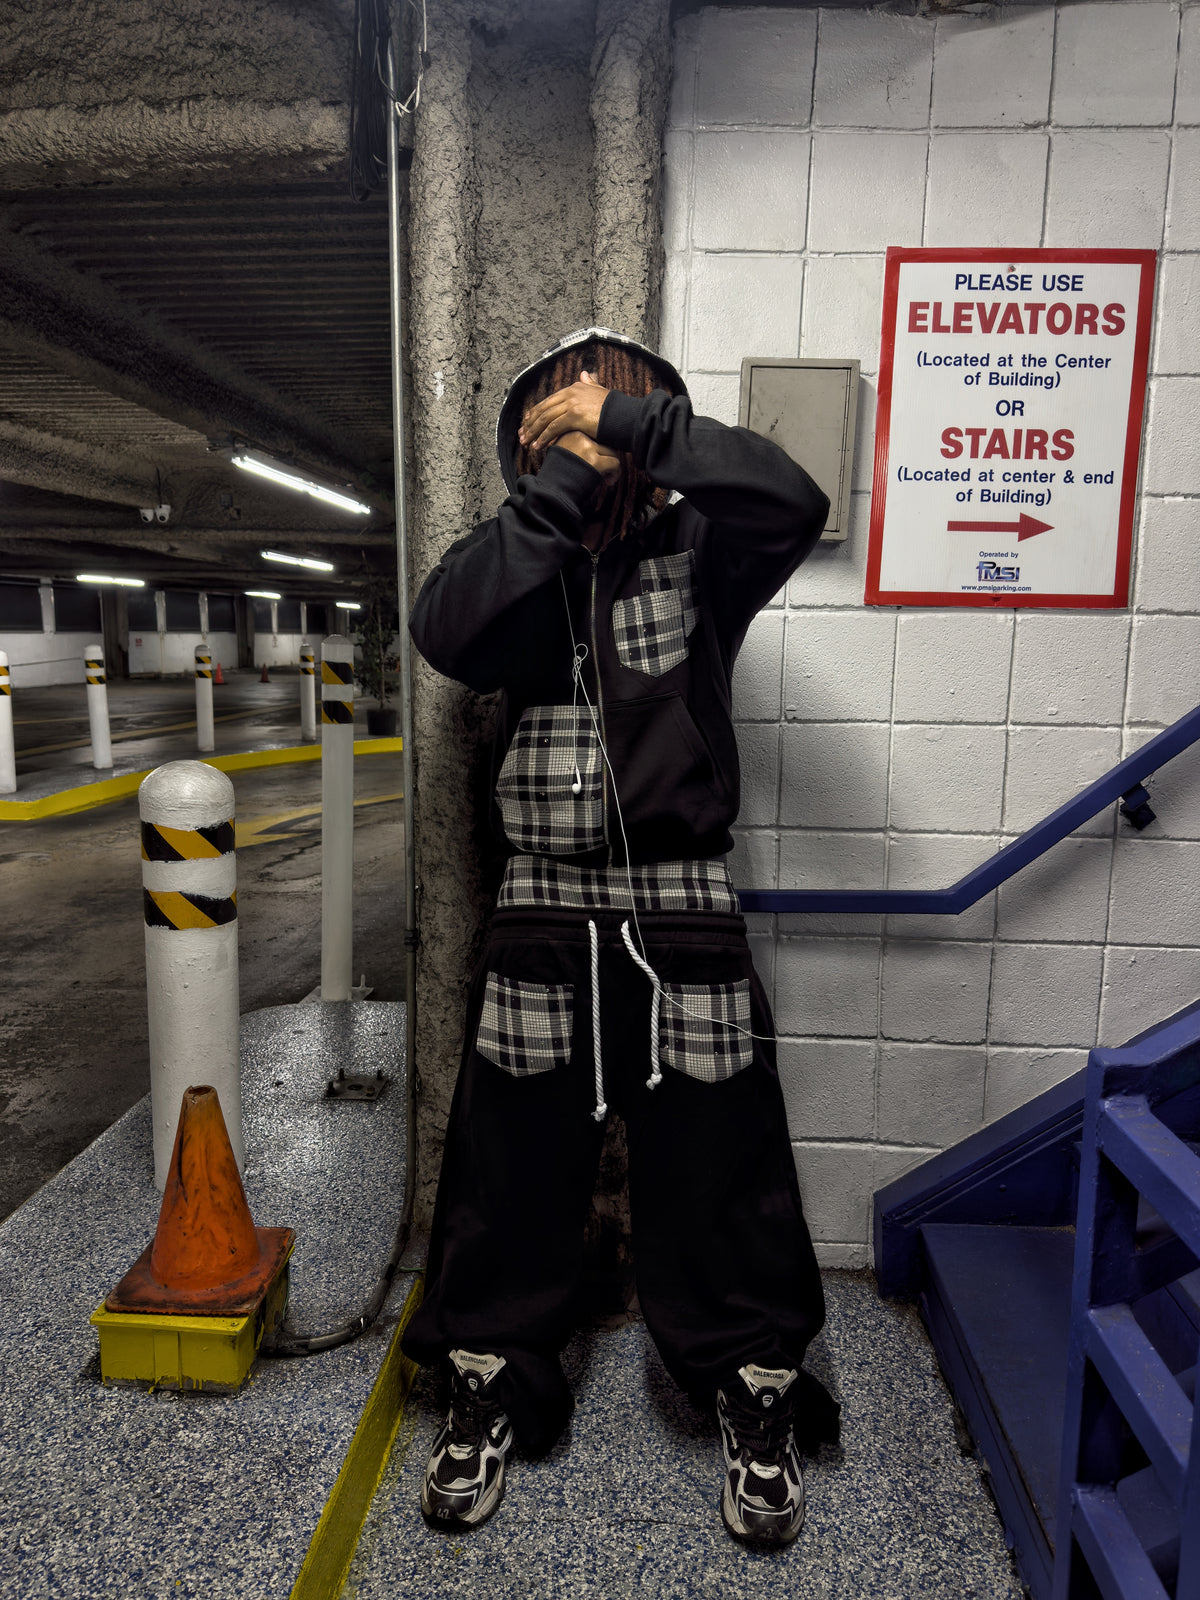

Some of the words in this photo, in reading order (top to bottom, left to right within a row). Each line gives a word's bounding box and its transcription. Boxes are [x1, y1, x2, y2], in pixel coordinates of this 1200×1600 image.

[954, 273, 1033, 291] PLEASE
[1042, 274, 1084, 292] USE
[907, 301, 1126, 336] ELEVATORS
[916, 350, 990, 368] (Located
[997, 354, 1014, 368] at
[1021, 353, 1047, 368] the
[1055, 353, 1112, 369] Center
[964, 371, 982, 386] of
[988, 371, 1061, 390] Building)
[995, 399, 1025, 417] OR
[940, 426, 1075, 461] STAIRS
[897, 465, 971, 483] (Located
[978, 469, 995, 483] at
[1002, 470, 1055, 484] center
[1063, 469, 1075, 484] &
[1083, 470, 1114, 485] end
[955, 488, 973, 502] of
[980, 488, 1051, 507] Building)
[979, 550, 1009, 559] Operated
[1010, 551, 1019, 559] by
[976, 561, 1020, 582] PMSI
[753, 1370, 784, 1379] BALENCIAGA
